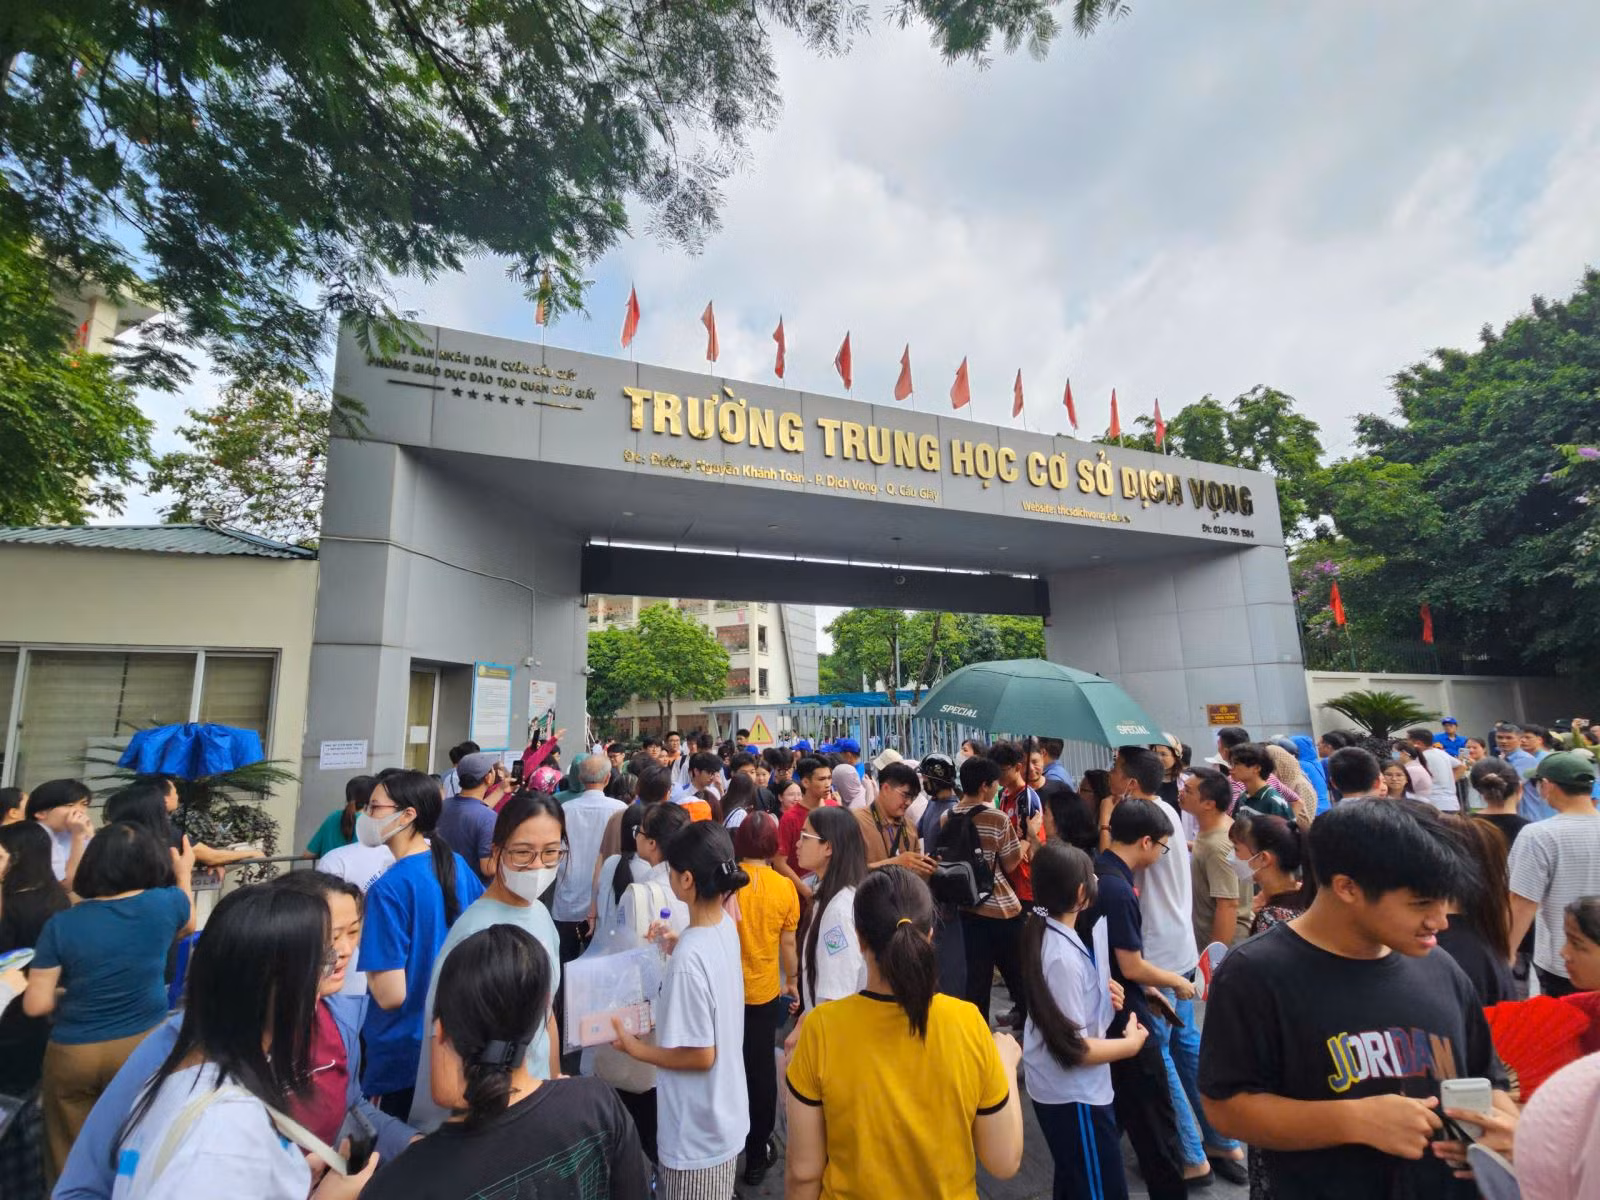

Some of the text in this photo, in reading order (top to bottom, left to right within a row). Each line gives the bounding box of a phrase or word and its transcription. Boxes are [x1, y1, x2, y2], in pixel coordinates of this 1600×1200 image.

[474, 356, 497, 368] DÂN
[413, 363, 441, 377] GIÁO
[444, 368, 467, 381] DỤC
[469, 372, 493, 384] ĐÀO
[497, 376, 517, 389] TẠO
[623, 386, 1254, 519] TRƯỜNG TRUNG HỌC CƠ SỞ DỊCH VỌNG
[742, 464, 777, 480] Khánh
[827, 474, 849, 490] Dịch
[852, 479, 877, 495] Vọng
[886, 483, 897, 496] Q.
[939, 704, 978, 718] SPECIAL
[1116, 724, 1150, 735] SPECIAL
[1327, 1028, 1456, 1093] JORDAN
